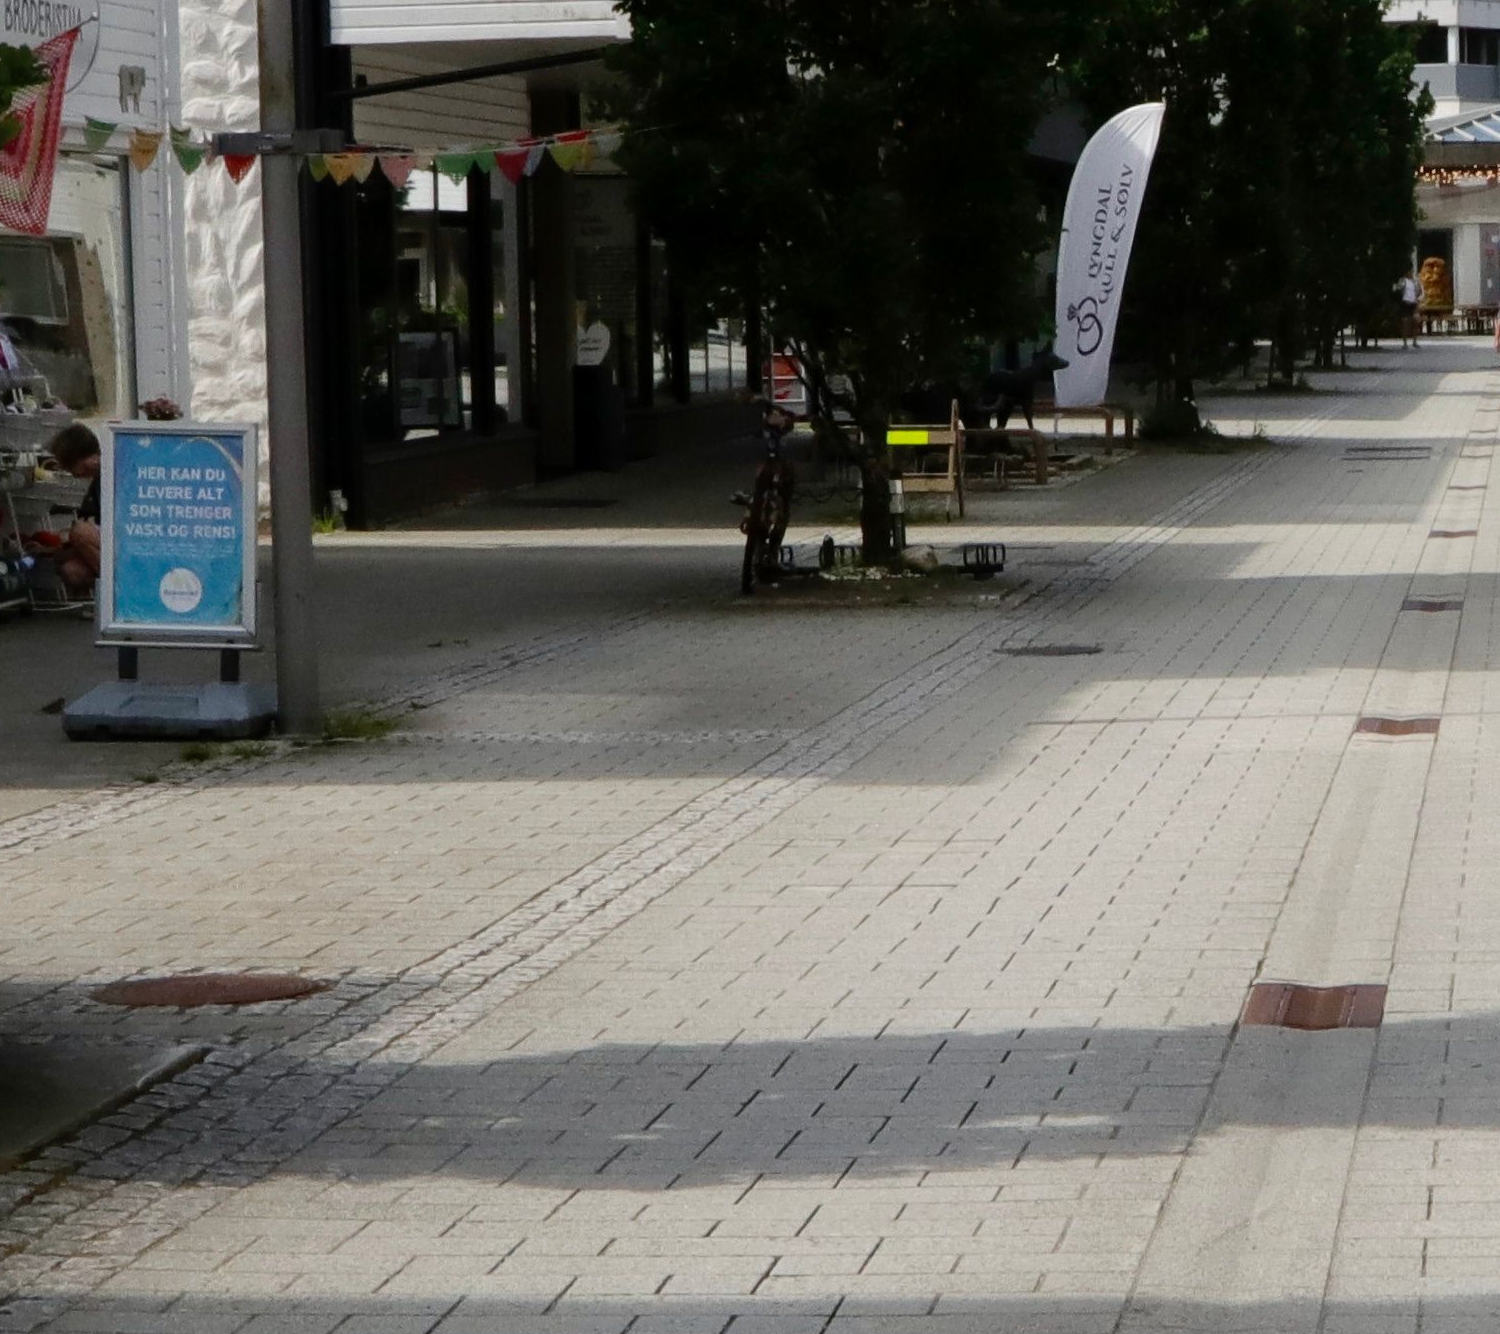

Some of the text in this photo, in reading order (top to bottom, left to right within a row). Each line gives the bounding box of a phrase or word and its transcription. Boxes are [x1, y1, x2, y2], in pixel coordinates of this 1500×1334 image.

[1087, 183, 1113, 278] LYNGDAL
[1098, 248, 1118, 305] GULL
[137, 466, 226, 482] HER KAN DU
[138, 486, 224, 501] LEVERE ALT
[130, 504, 232, 520] SOM TRENGER
[125, 523, 236, 540] VASK OG RENS!
